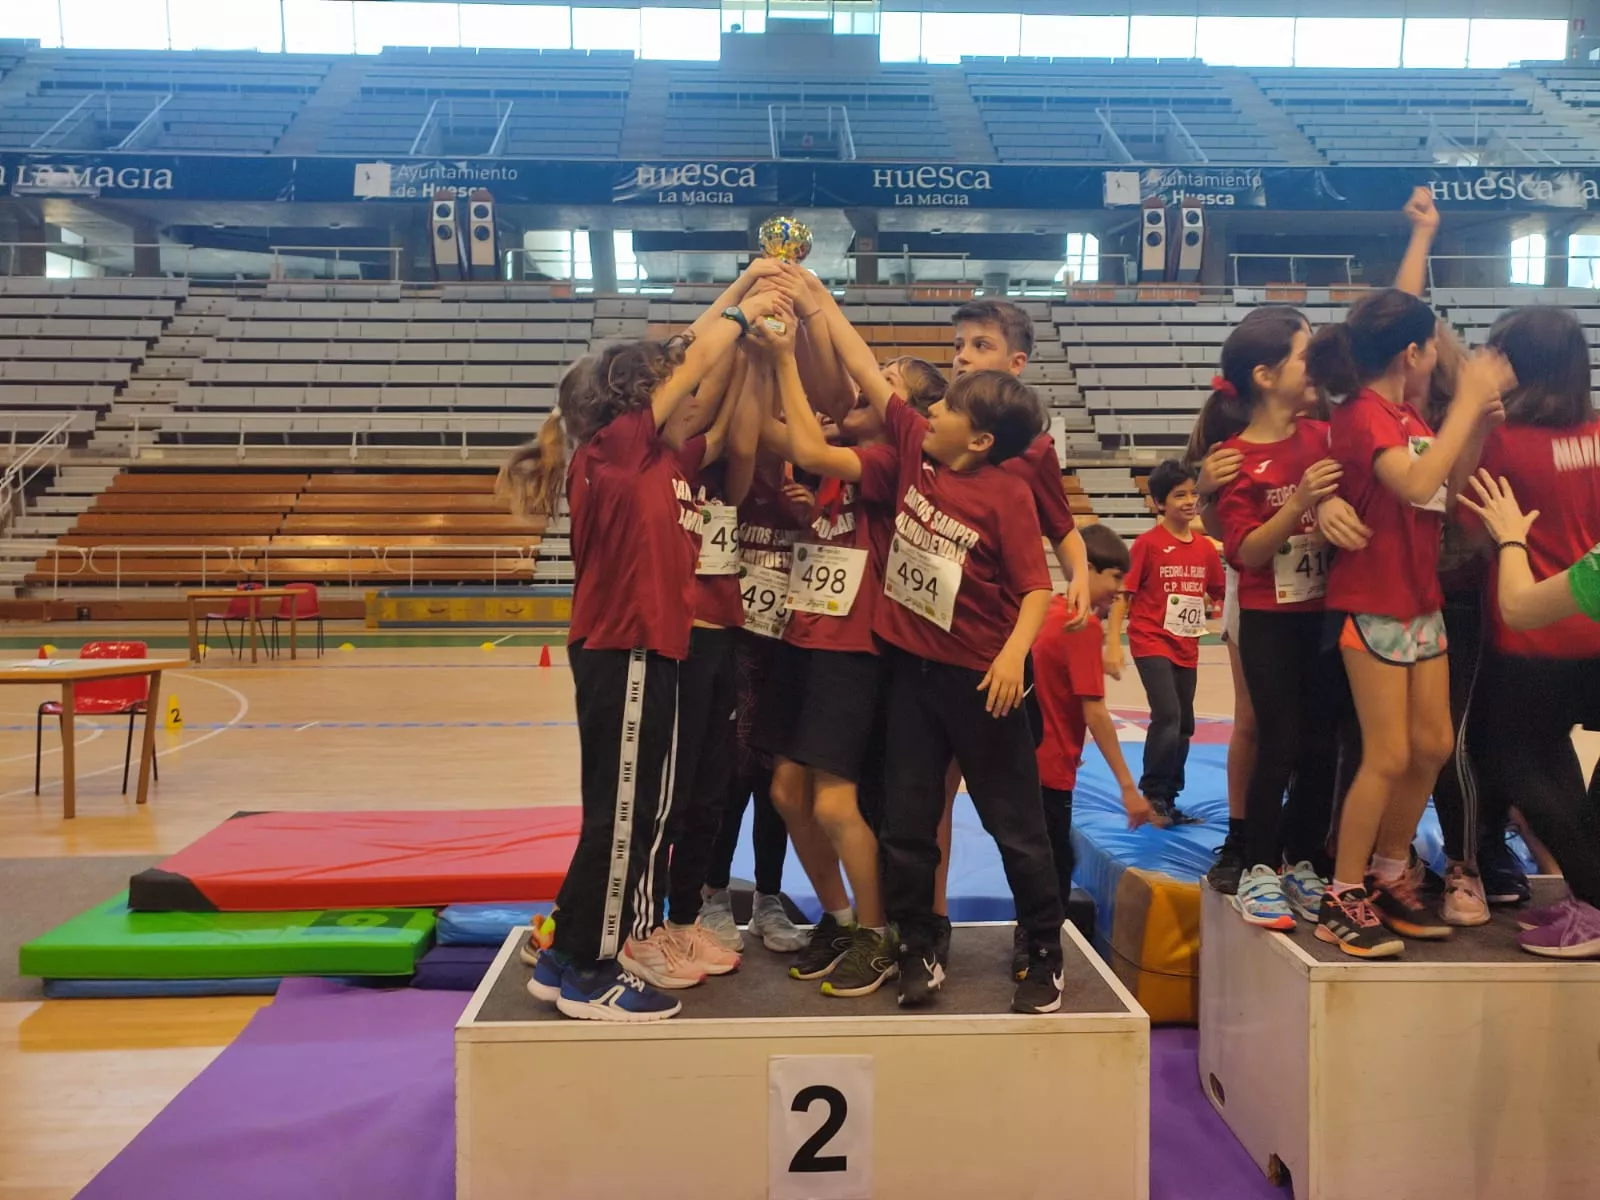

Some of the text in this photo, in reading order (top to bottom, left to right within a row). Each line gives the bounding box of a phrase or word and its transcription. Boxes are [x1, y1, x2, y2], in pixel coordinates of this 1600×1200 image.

[397, 163, 518, 183] Ayuntamiento
[396, 182, 489, 198] de Hesc
[801, 564, 847, 594] 498
[897, 561, 939, 603] 494
[170, 707, 182, 724] 2
[619, 801, 629, 821] NIKE
[616, 839, 626, 860] NIKE
[611, 877, 622, 898] NIKE
[607, 914, 617, 936] NIKE
[788, 1085, 847, 1173] 2
